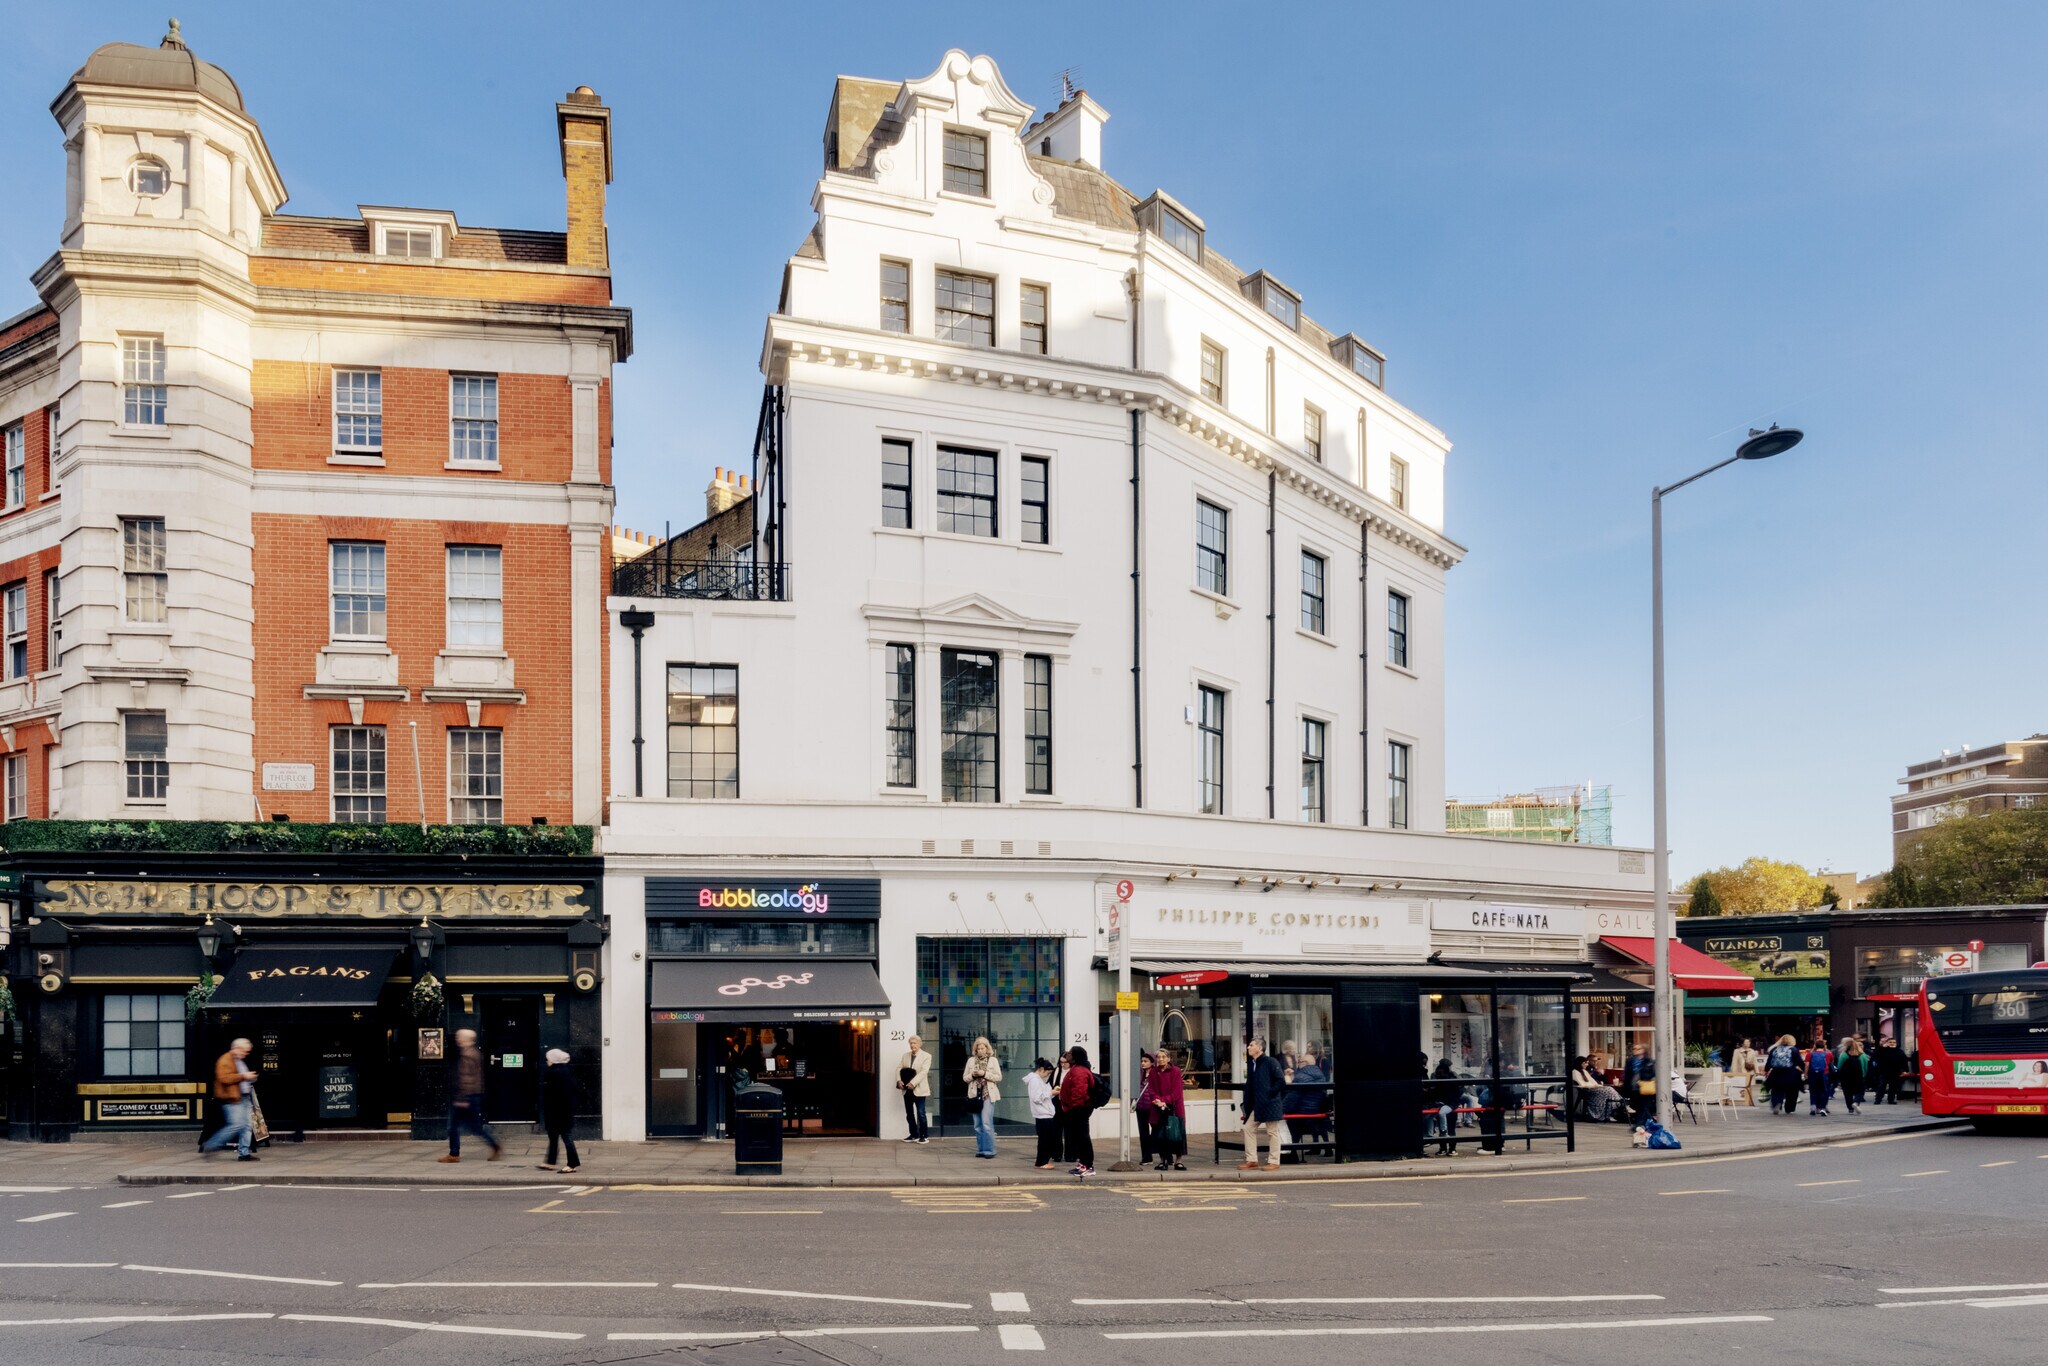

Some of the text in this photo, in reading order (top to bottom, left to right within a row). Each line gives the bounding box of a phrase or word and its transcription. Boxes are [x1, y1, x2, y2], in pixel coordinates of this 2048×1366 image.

[1119, 882, 1129, 897] S
[187, 883, 310, 912] HOOP
[326, 885, 351, 911] &
[368, 885, 453, 914] TOY
[699, 887, 828, 913] Bubbleology
[1158, 908, 1380, 928] PHILIPPE CONTICINI
[1472, 909, 1506, 926] CAFÉ
[1517, 915, 1549, 928] NATA
[943, 928, 1080, 937] ALFRED HOUSE
[1259, 928, 1286, 936] PARIS
[1708, 940, 1778, 951] VIANDAS
[1970, 941, 1980, 950] T
[247, 966, 372, 980] FAGANS
[1997, 1001, 2026, 1017] 360
[890, 1030, 905, 1041] 23
[1074, 1033, 1089, 1043] 24
[1957, 1061, 2009, 1075] Pregnacare
[324, 1084, 353, 1093] SPORTS
[149, 1103, 168, 1111] CLUB
